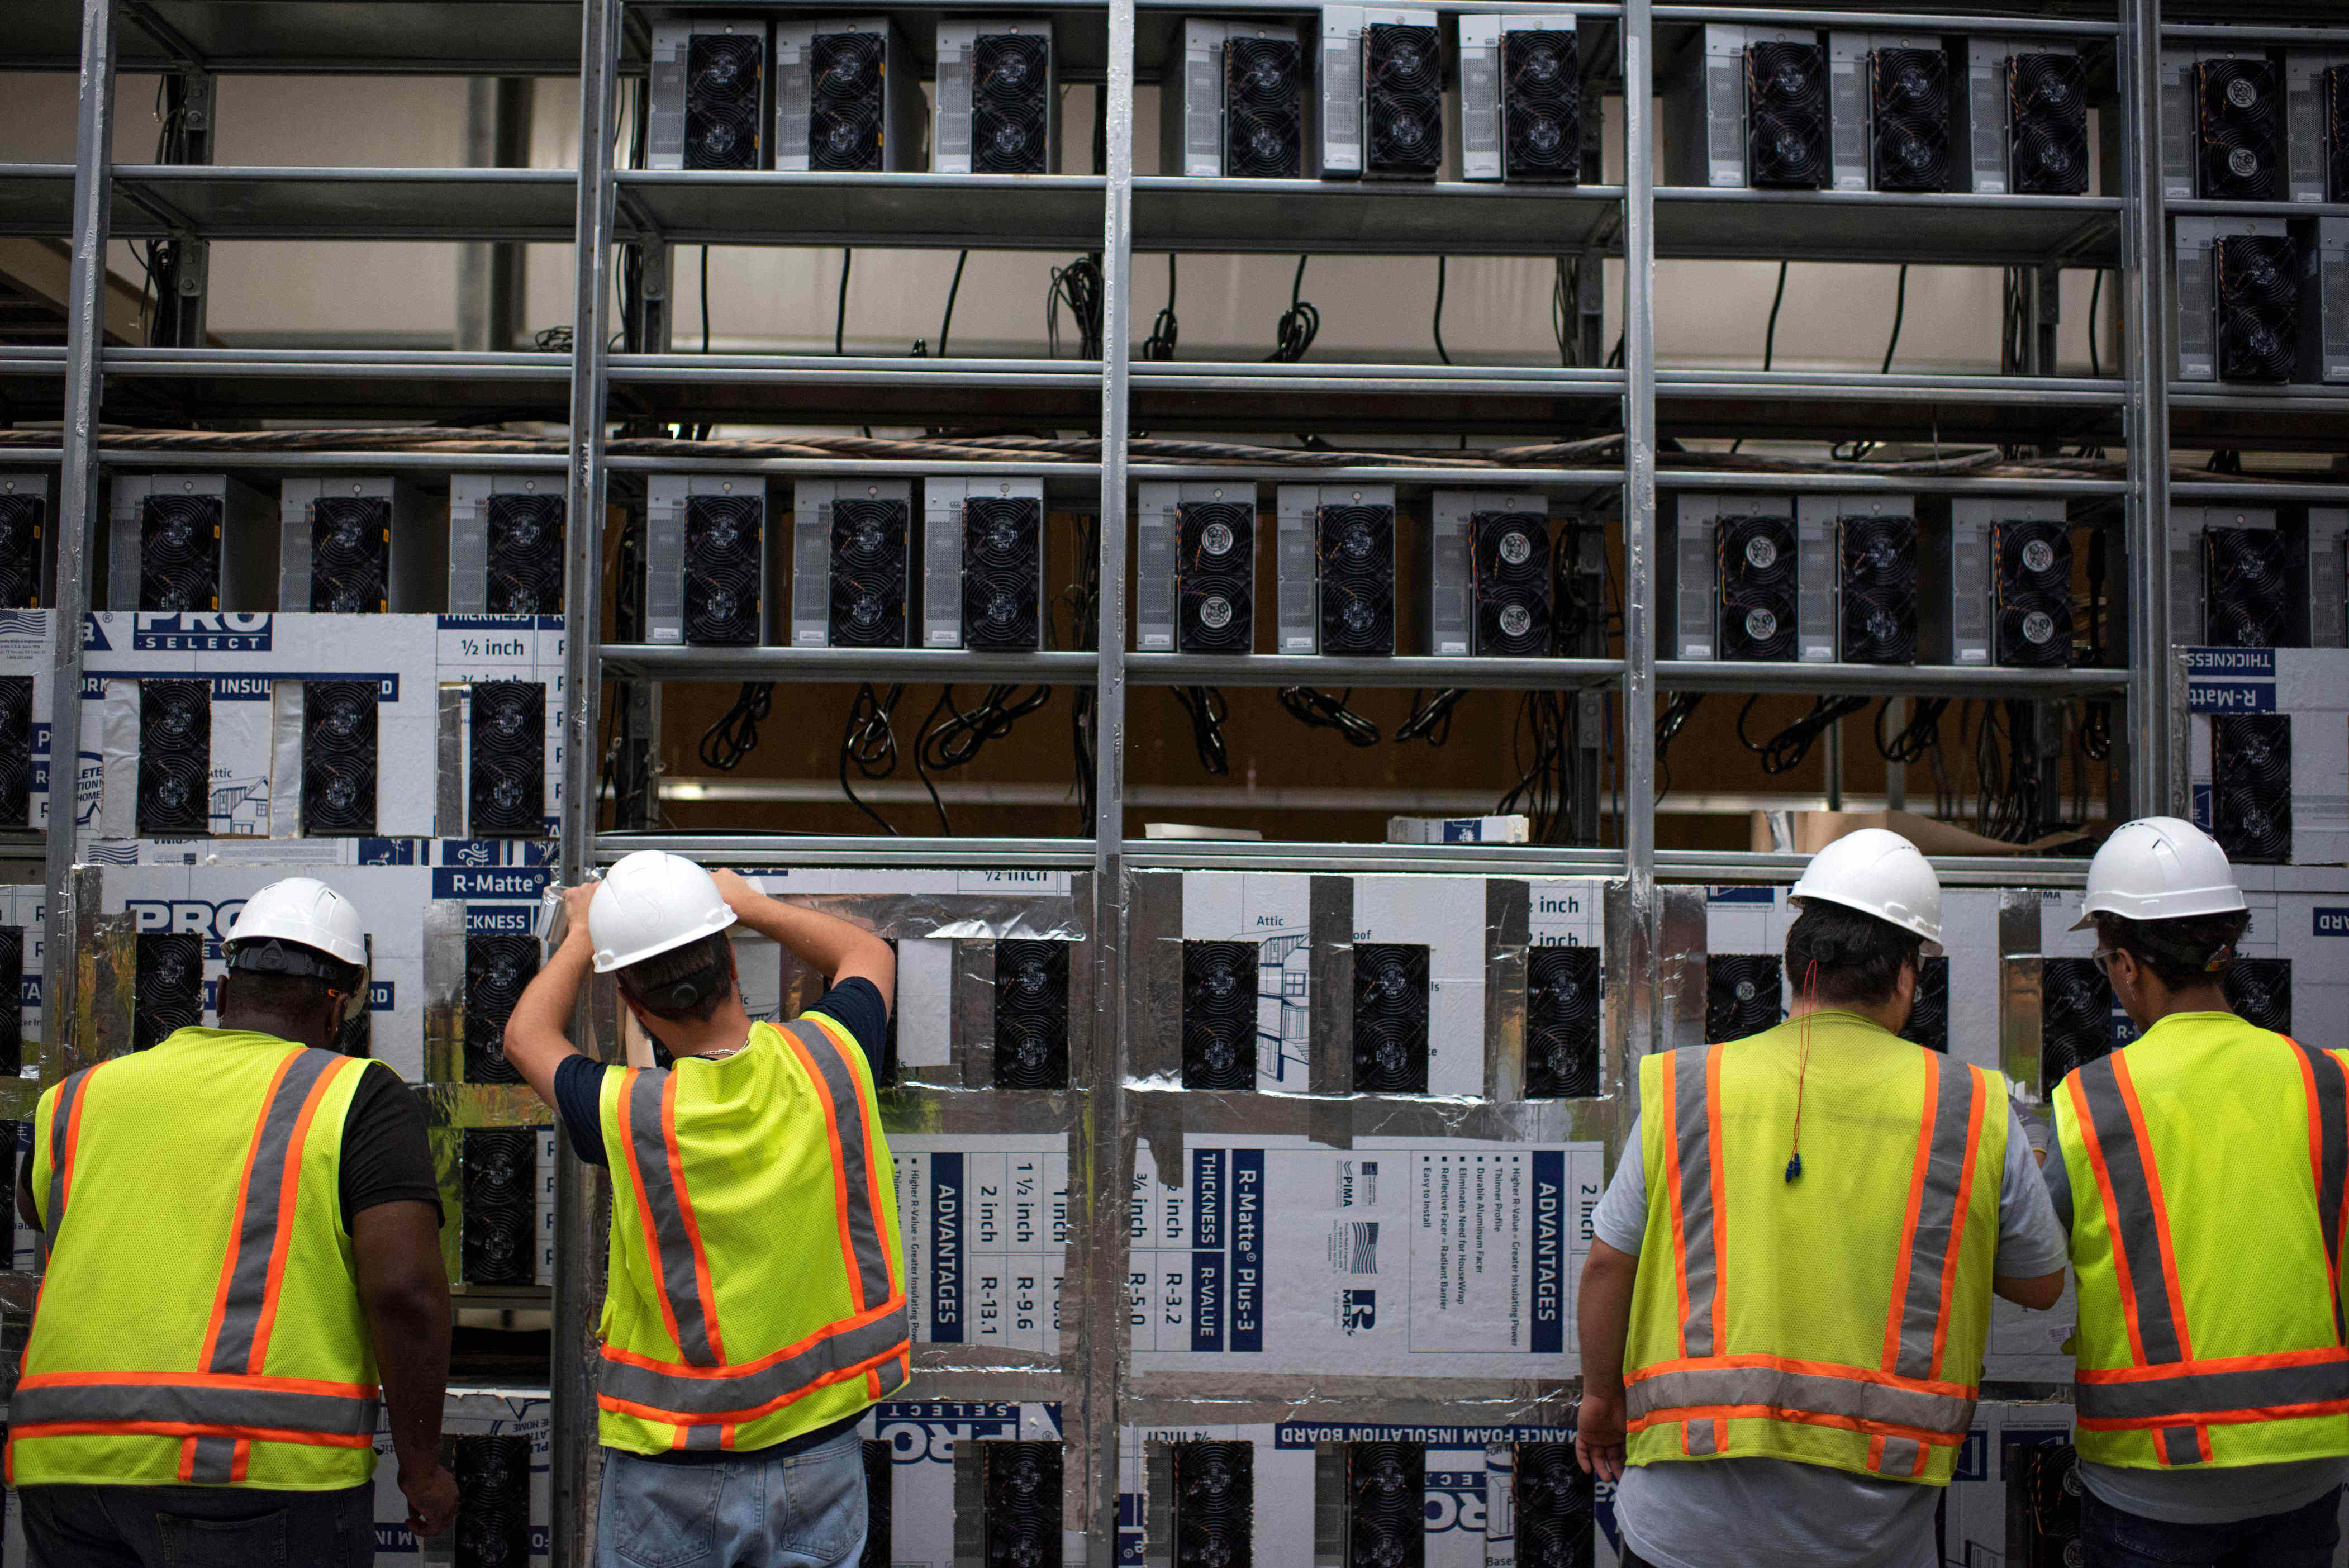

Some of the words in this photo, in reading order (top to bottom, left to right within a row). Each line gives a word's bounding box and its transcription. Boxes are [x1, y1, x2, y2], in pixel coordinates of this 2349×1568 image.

[145, 638, 259, 649] SELECT
[486, 639, 524, 655] inch
[2187, 653, 2271, 667] THICKNESS
[1540, 896, 1578, 913] inch
[466, 915, 525, 930] CKNESS
[1257, 916, 1284, 926] Attic
[1353, 930, 1371, 940] oof
[910, 1170, 919, 1198] Higher
[981, 1185, 997, 1196] 2
[1342, 1176, 1353, 1208] PIMA
[1421, 1168, 1432, 1187] Easy
[1440, 1168, 1449, 1211] Reflective
[1458, 1168, 1467, 1213] Eliminates
[1476, 1168, 1485, 1201] Durable
[1495, 1168, 1503, 1201] Thinner
[1511, 1168, 1520, 1195] Higher
[1581, 1184, 1597, 1195] 2
[1201, 1153, 1216, 1244] THICKNESS
[1423, 1190, 1431, 1199] to
[981, 1202, 998, 1243] inch
[1017, 1202, 1034, 1243] inch
[1131, 1199, 1148, 1238] inch
[1166, 1199, 1184, 1239] inch
[1423, 1201, 1432, 1228] Install
[1440, 1213, 1449, 1236] Facer
[1458, 1215, 1467, 1238] Need
[1476, 1203, 1485, 1248] Aluminum
[1494, 1203, 1503, 1232] Profile
[1581, 1201, 1597, 1241] inch
[938, 1184, 957, 1324] ADVANTAGES
[1458, 1241, 1467, 1252] for
[1511, 1242, 1520, 1272] Greater
[1538, 1182, 1556, 1322] ADVANTAGES
[1440, 1246, 1449, 1280] Radiant
[1476, 1251, 1485, 1274] Facer
[1455, 1255, 1467, 1305] HouseWrap
[909, 1278, 919, 1320] Insulating
[981, 1276, 997, 1335] R-13.1
[1017, 1277, 1033, 1330] R-9.6
[1130, 1272, 1146, 1325] R-5.0
[1166, 1273, 1182, 1325] R-3.2
[1200, 1267, 1215, 1337] R-VALUE
[1238, 1268, 1256, 1331] Plus-3
[1439, 1282, 1448, 1310] Barrier
[1509, 1275, 1519, 1318] Insulating
[910, 1323, 919, 1342] Pow
[1510, 1320, 1519, 1347] Power
[888, 1405, 1007, 1417] SELECT
[1282, 1428, 1343, 1442] BOARD
[1349, 1428, 1458, 1443] INSULATION
[1463, 1428, 1514, 1443] FOAM
